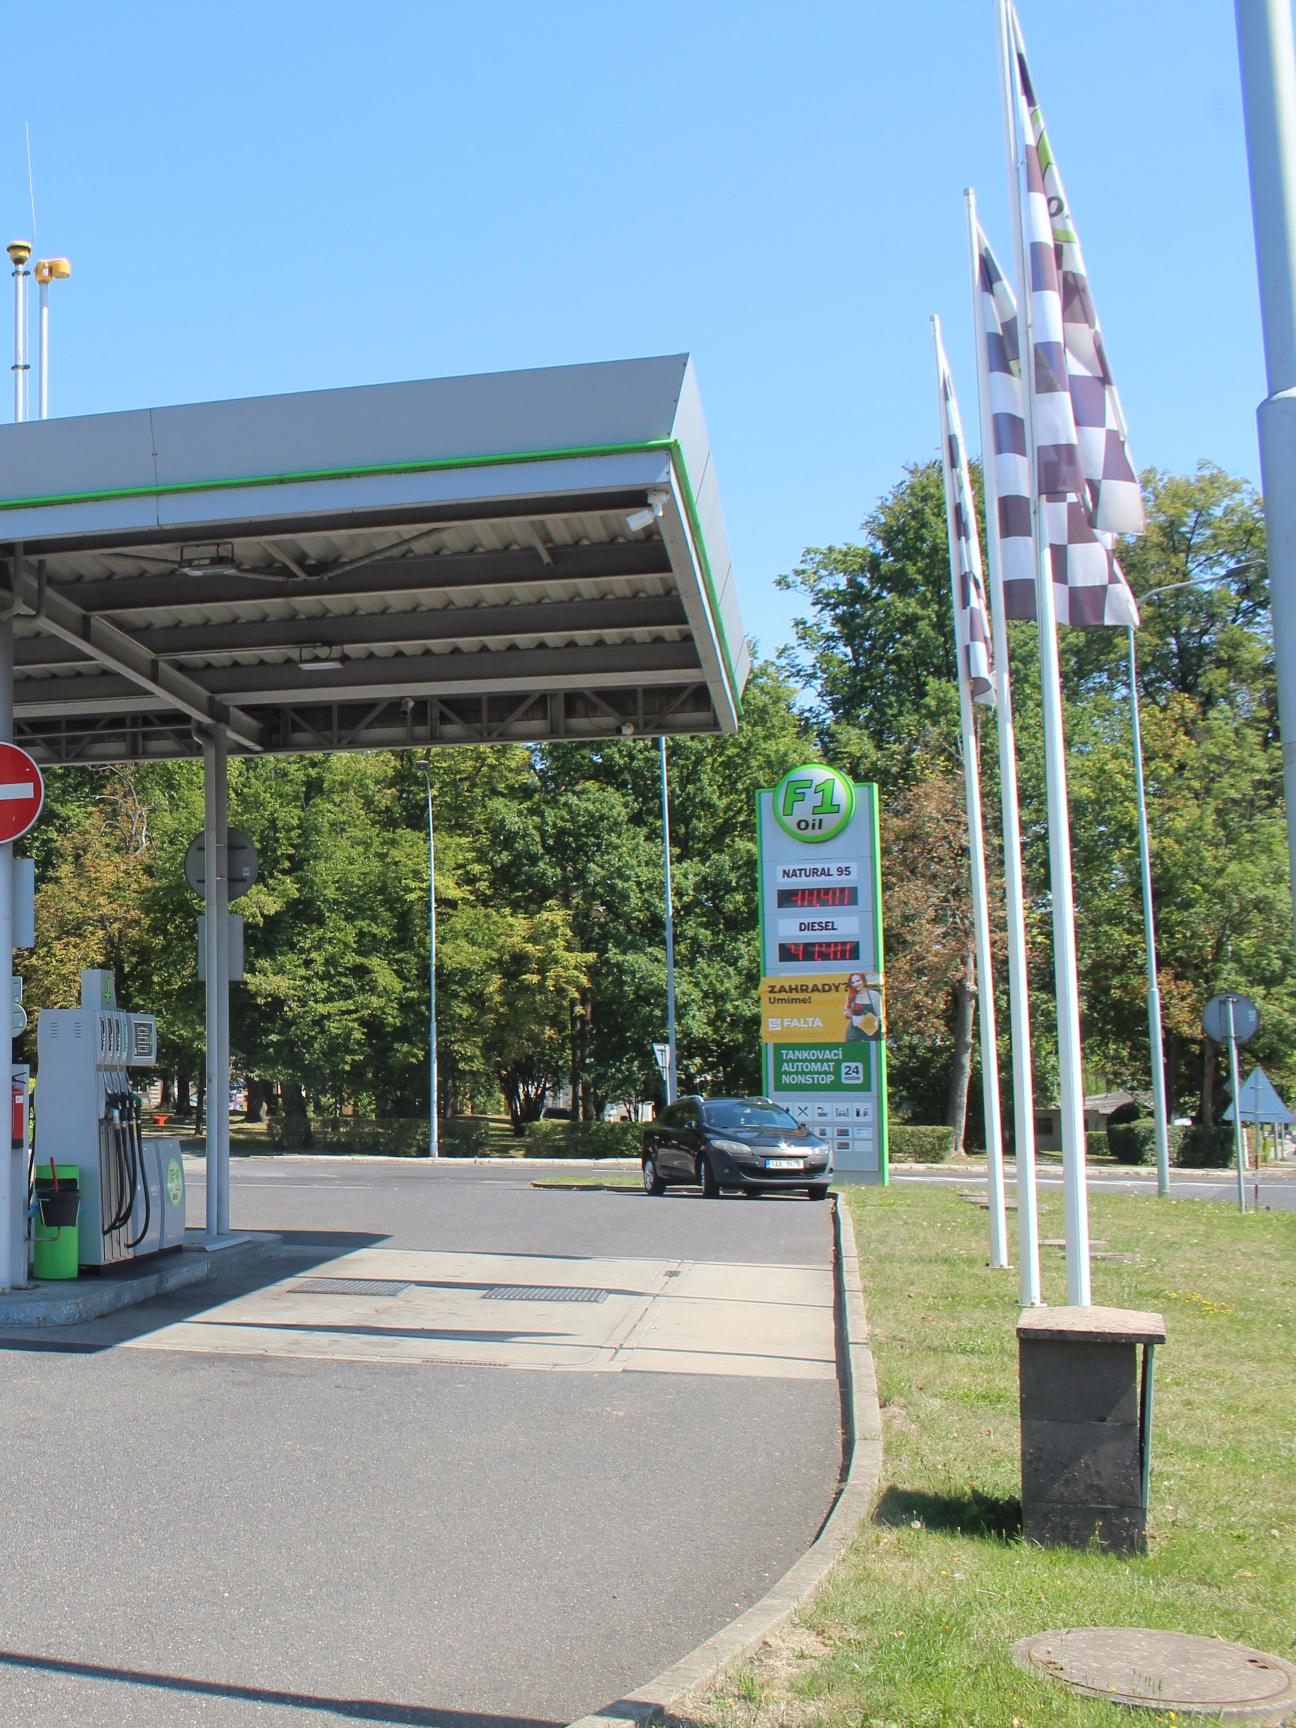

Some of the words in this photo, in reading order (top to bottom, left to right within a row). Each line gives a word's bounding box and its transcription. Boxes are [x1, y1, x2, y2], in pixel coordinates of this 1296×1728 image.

[783, 778, 840, 816] F1
[796, 818, 823, 831] Oil
[782, 867, 833, 879] NATURAL
[836, 866, 851, 876] 95
[799, 921, 838, 932] DIESEL
[103, 976, 113, 1004] 4
[768, 982, 850, 994] ZAHRADY?
[784, 1017, 823, 1028] FALTA
[781, 1048, 843, 1060] TANKOVACÍ
[781, 1062, 835, 1072] AUTOMAT
[844, 1065, 860, 1076] 24
[782, 1074, 834, 1084] NONSTOP
